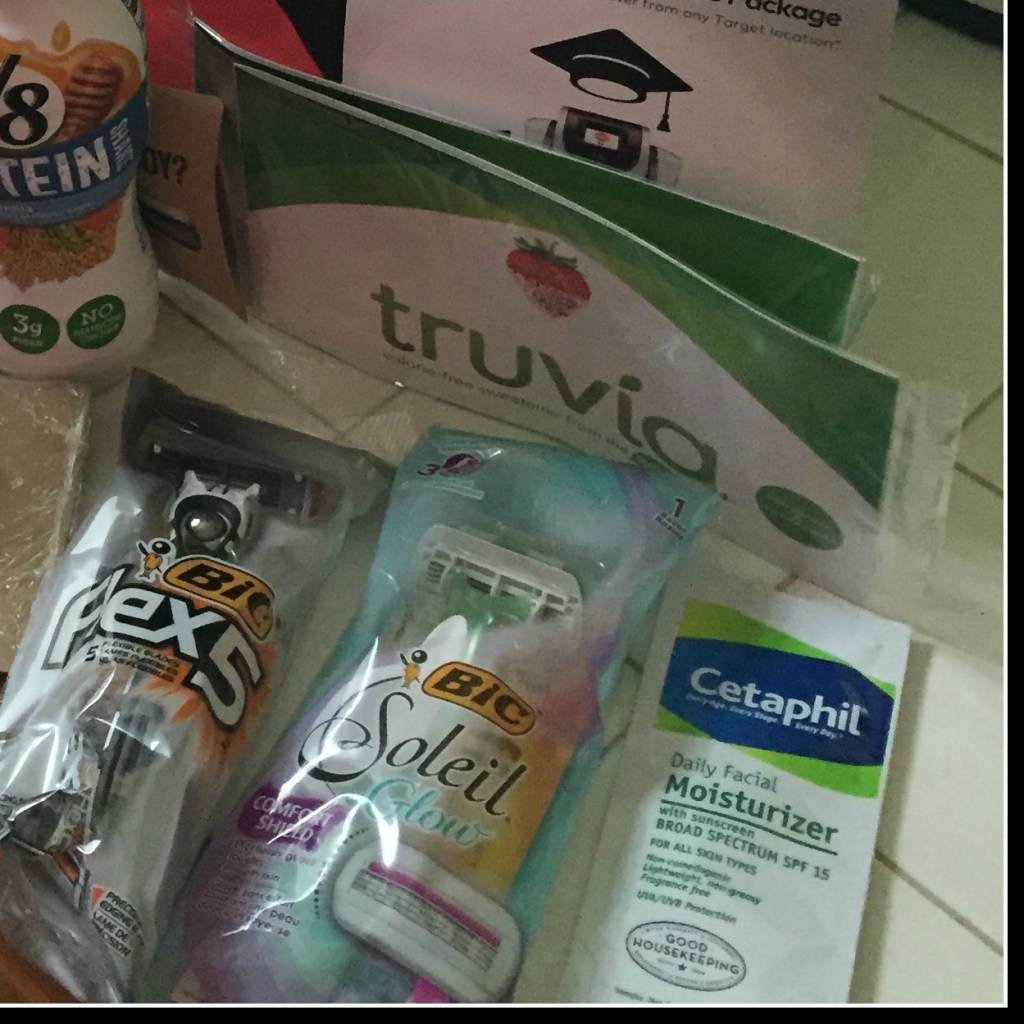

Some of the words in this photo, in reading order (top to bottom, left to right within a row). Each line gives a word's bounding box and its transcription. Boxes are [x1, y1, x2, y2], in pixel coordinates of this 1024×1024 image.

[681, 8, 710, 24] any
[714, 14, 765, 37] Target
[12, 312, 43, 337] 3g
[81, 303, 114, 326] NO
[370, 282, 719, 490] truvia
[103, 640, 142, 654] FEXIBLE
[690, 667, 861, 737] Cetaphil
[298, 678, 528, 817] Soleil
[671, 752, 717, 778] Daily
[724, 765, 778, 793] Facial
[364, 778, 490, 849] Glow
[659, 806, 687, 820] with
[690, 812, 755, 838] sunscreen
[665, 774, 839, 844] Moisturizer
[650, 838, 670, 850] FOR
[673, 843, 692, 855] ALL
[696, 847, 723, 863] SKIN
[725, 856, 757, 876] TYPES
[656, 819, 702, 838] BROAD
[707, 830, 778, 863] SPECTRUM
[784, 855, 809, 873] SPF
[813, 866, 830, 881] 15
[689, 885, 711, 899] free
[270, 909, 300, 927] peau
[633, 938, 740, 976] HOUSEKEEPING
[665, 933, 708, 953] GOOD
